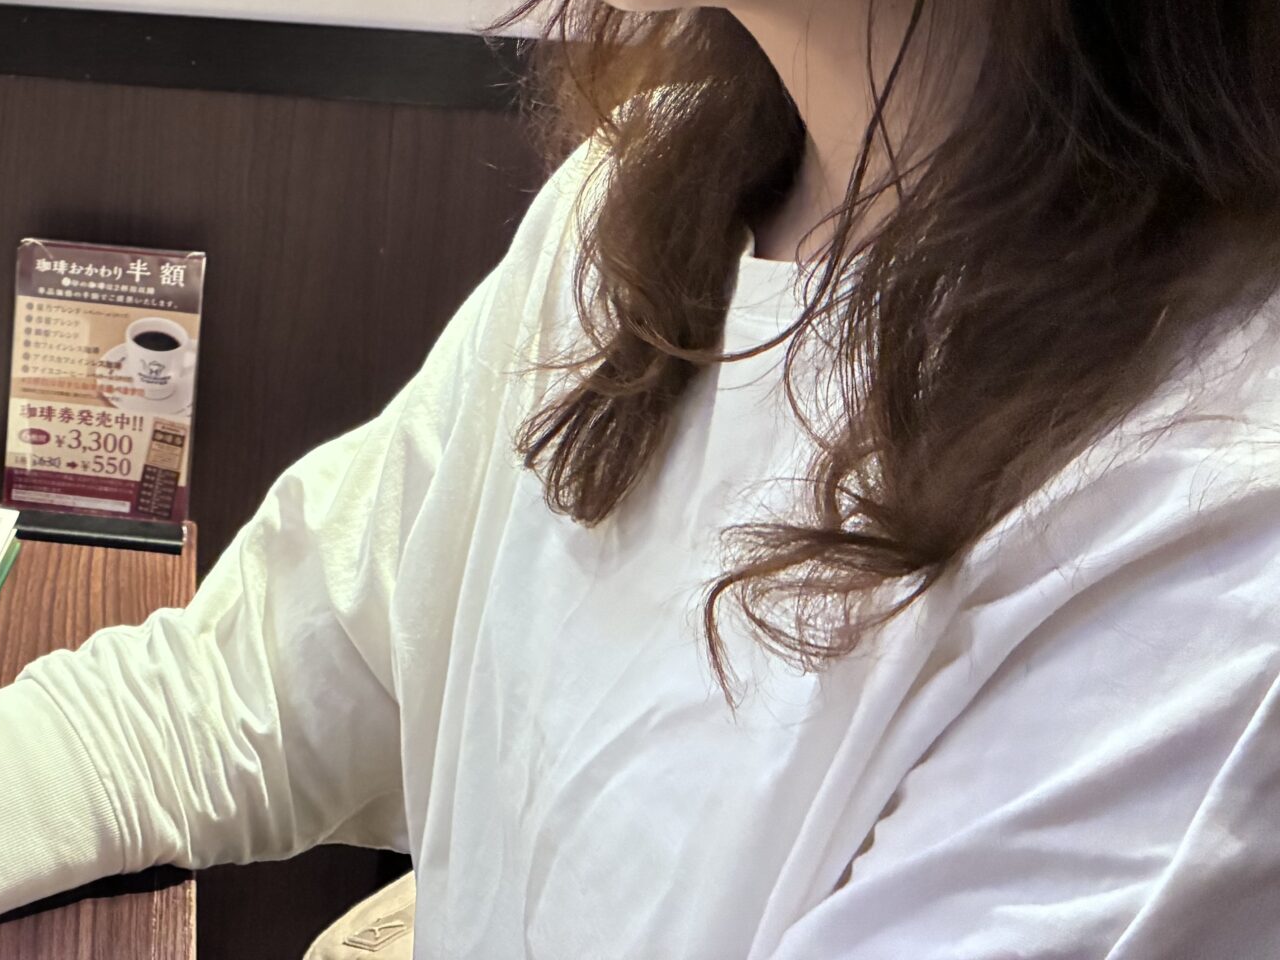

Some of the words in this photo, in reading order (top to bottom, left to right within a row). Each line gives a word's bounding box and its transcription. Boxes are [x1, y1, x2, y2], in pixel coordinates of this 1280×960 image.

[35, 258, 123, 281] 珈琲おかわり
[126, 259, 187, 288] 半額
[55, 429, 134, 456] ¥3,300
[81, 455, 132, 477] ¥550
